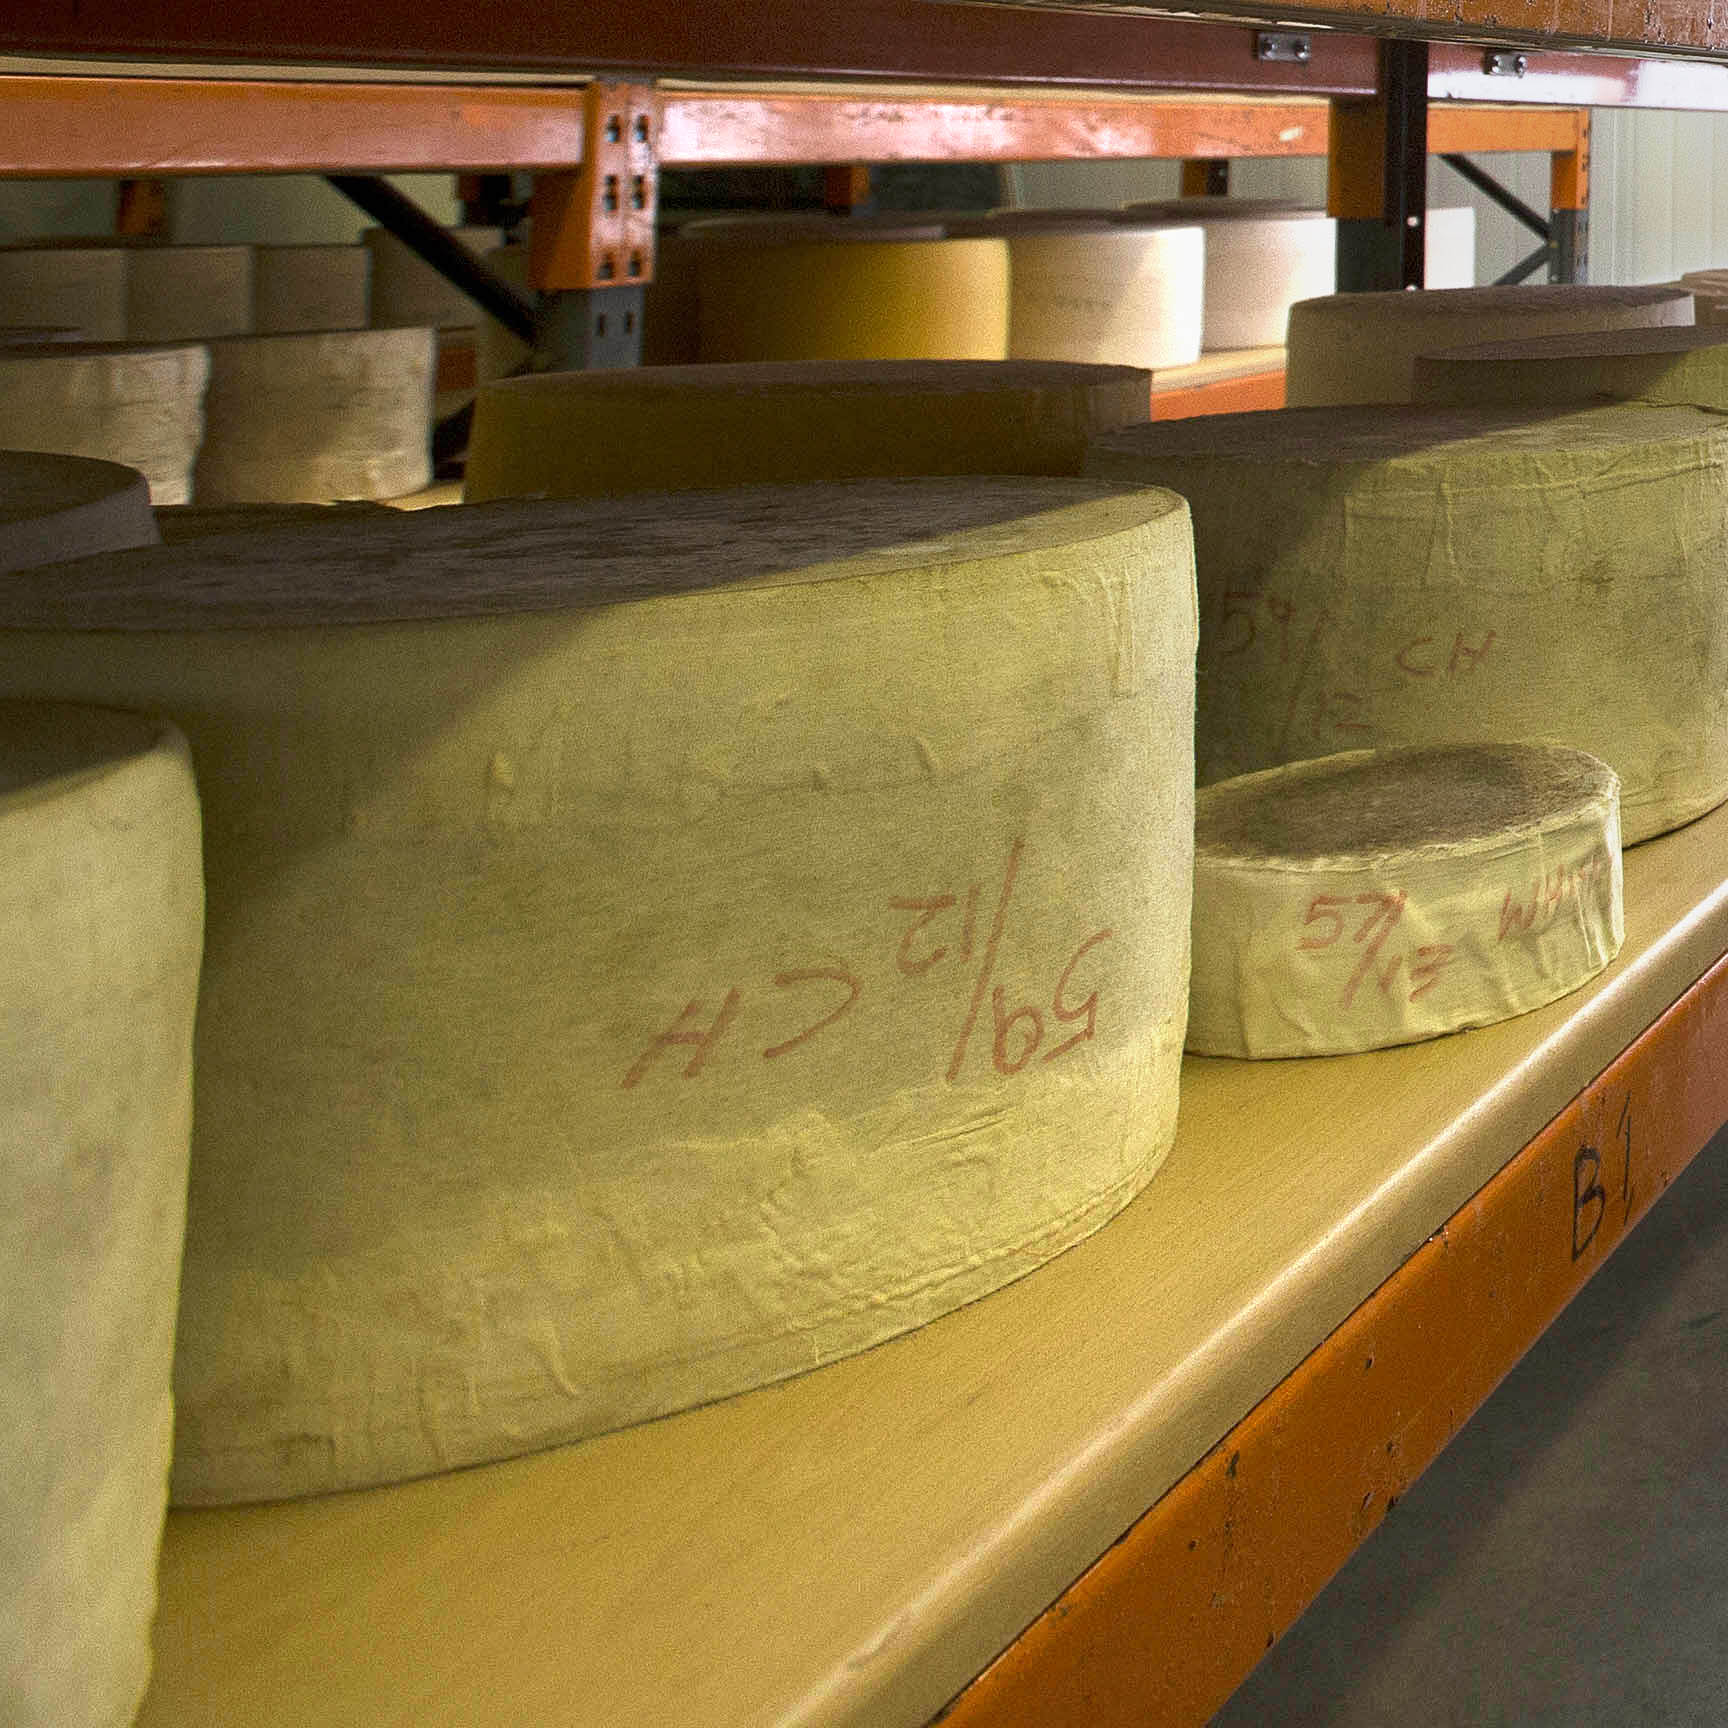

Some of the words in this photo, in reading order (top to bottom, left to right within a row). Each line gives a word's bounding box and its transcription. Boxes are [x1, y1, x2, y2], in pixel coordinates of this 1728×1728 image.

[1395, 629, 1498, 681] CH
[620, 967, 863, 1090] CH
[1570, 1089, 1634, 1264] B1
